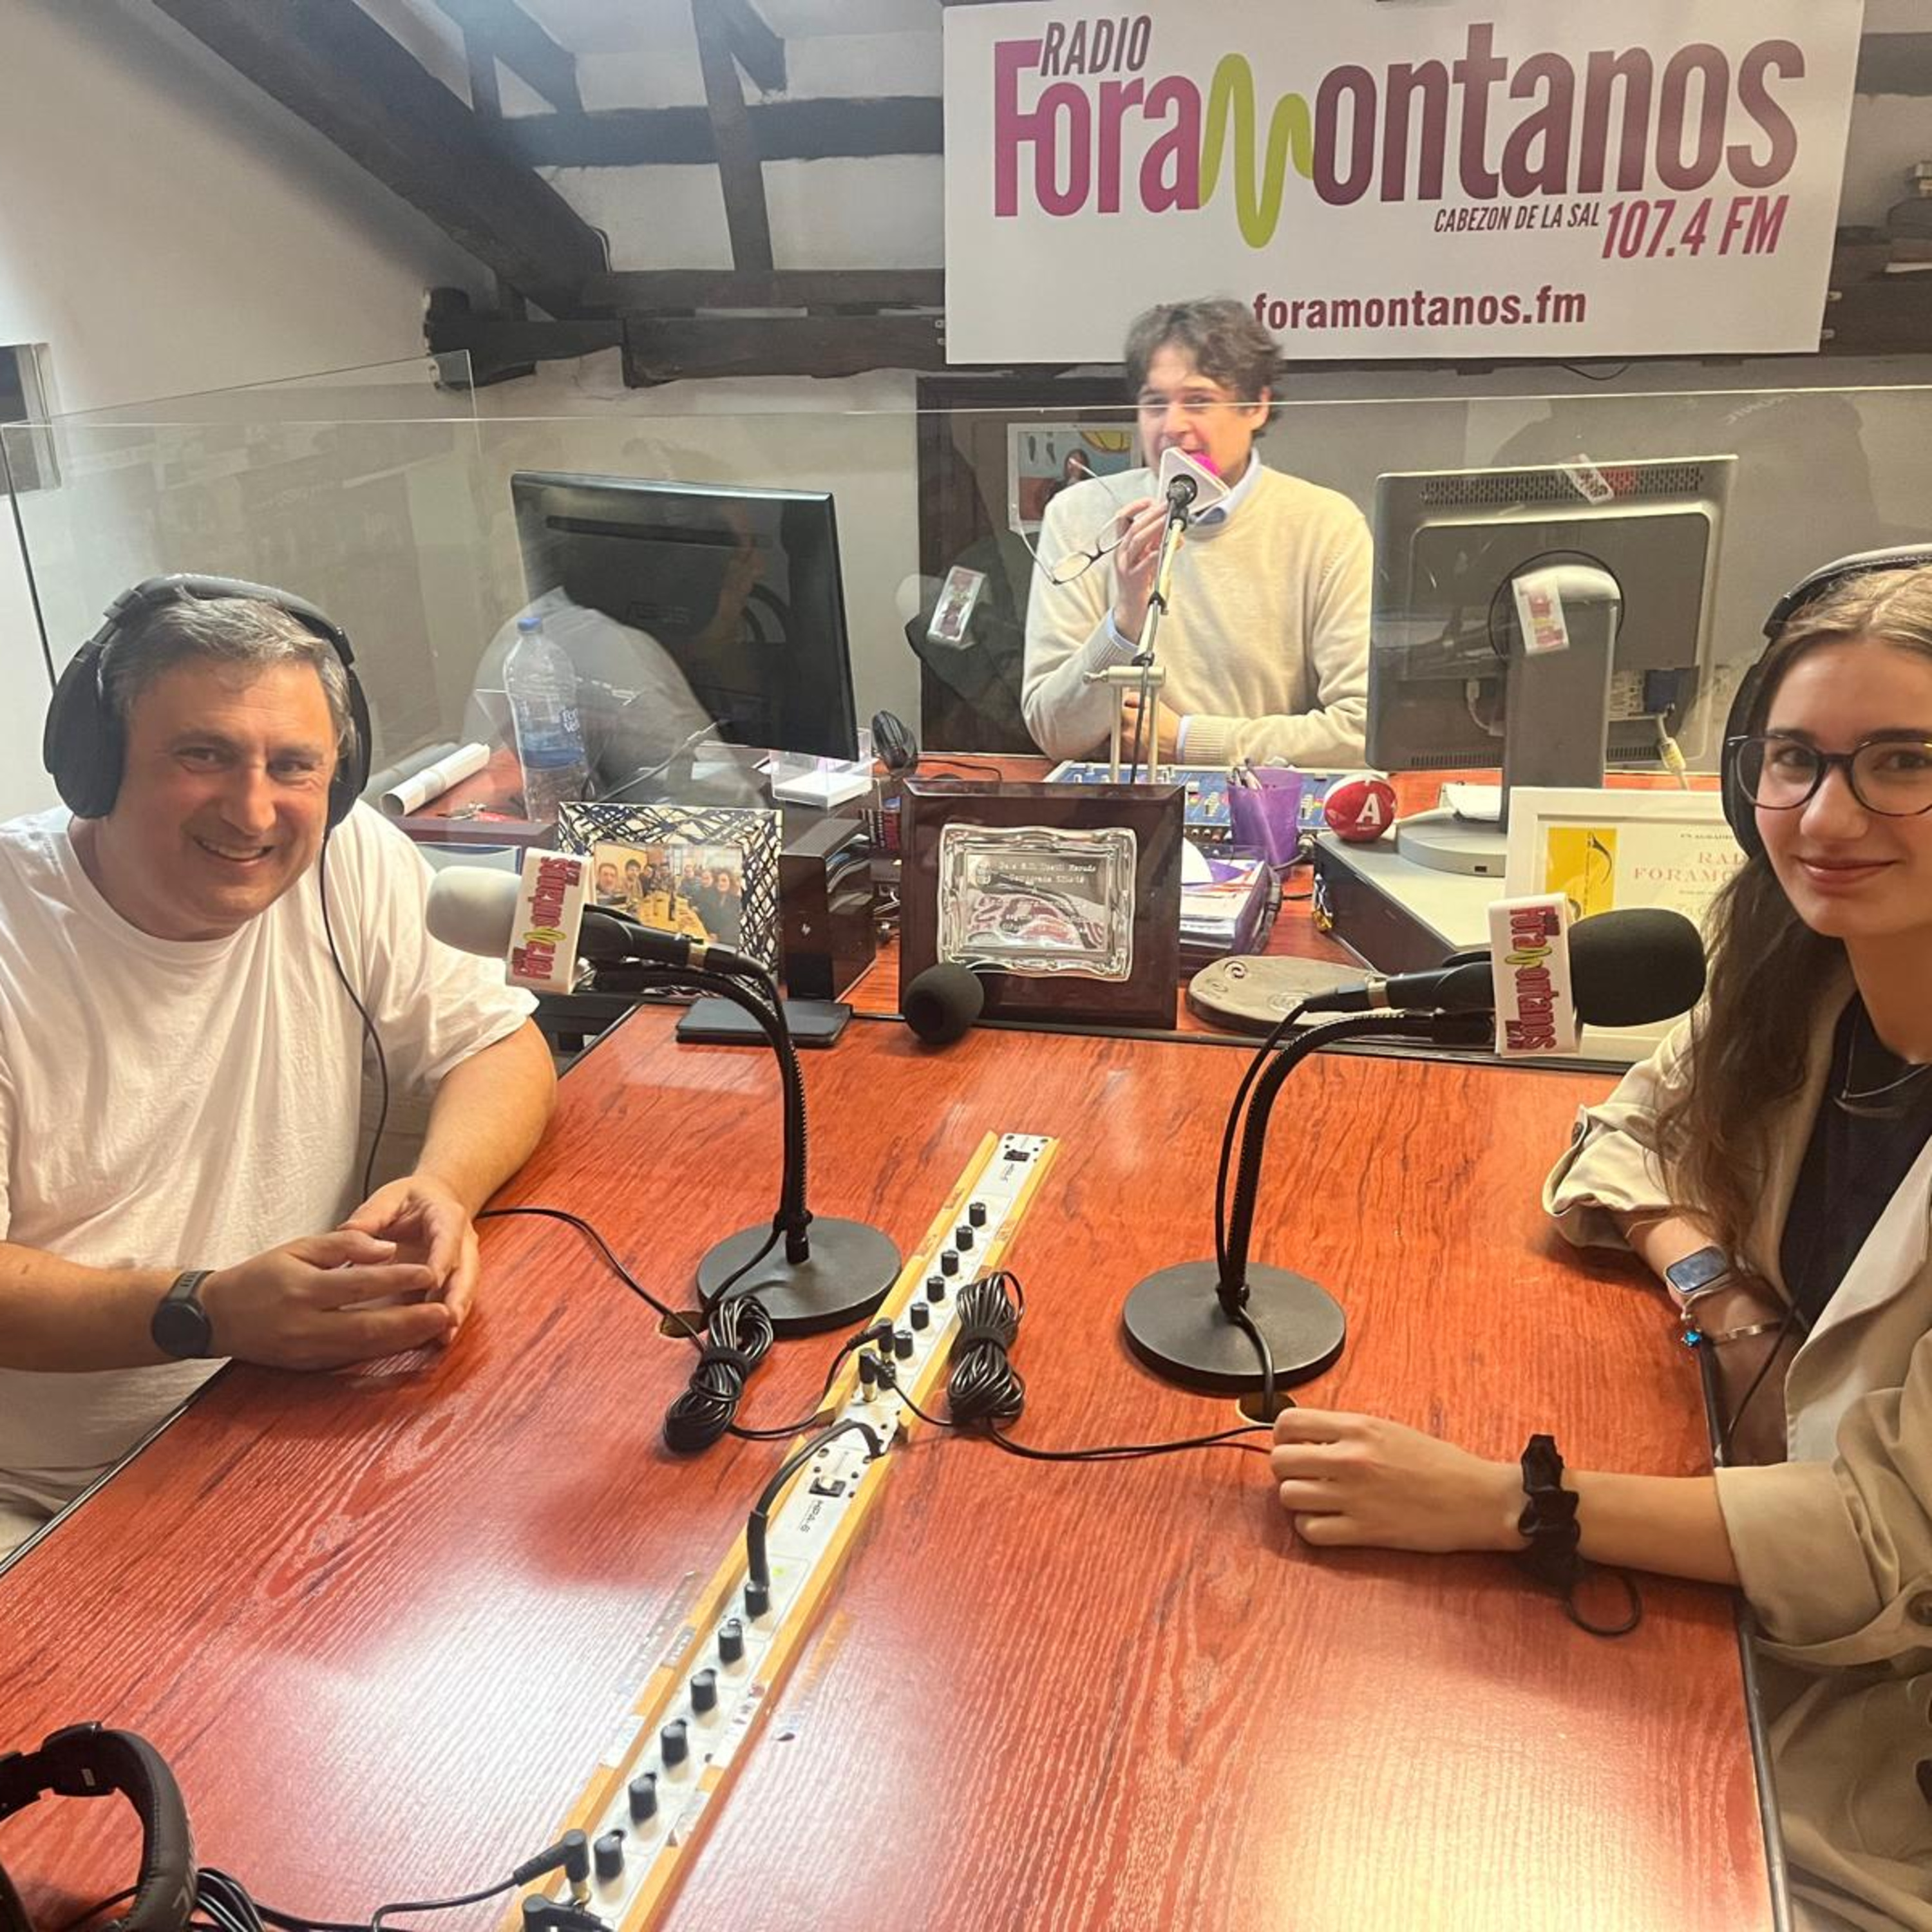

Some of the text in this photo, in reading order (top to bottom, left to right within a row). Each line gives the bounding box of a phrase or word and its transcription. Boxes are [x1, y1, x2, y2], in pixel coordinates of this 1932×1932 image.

[1040, 15, 1151, 77] RADIO
[1434, 202, 1600, 232] CABEZON DE LA SAL
[1602, 195, 1790, 259] 107.4 FM
[1253, 285, 1586, 330] foramontanos.fm
[1356, 793, 1382, 825] A
